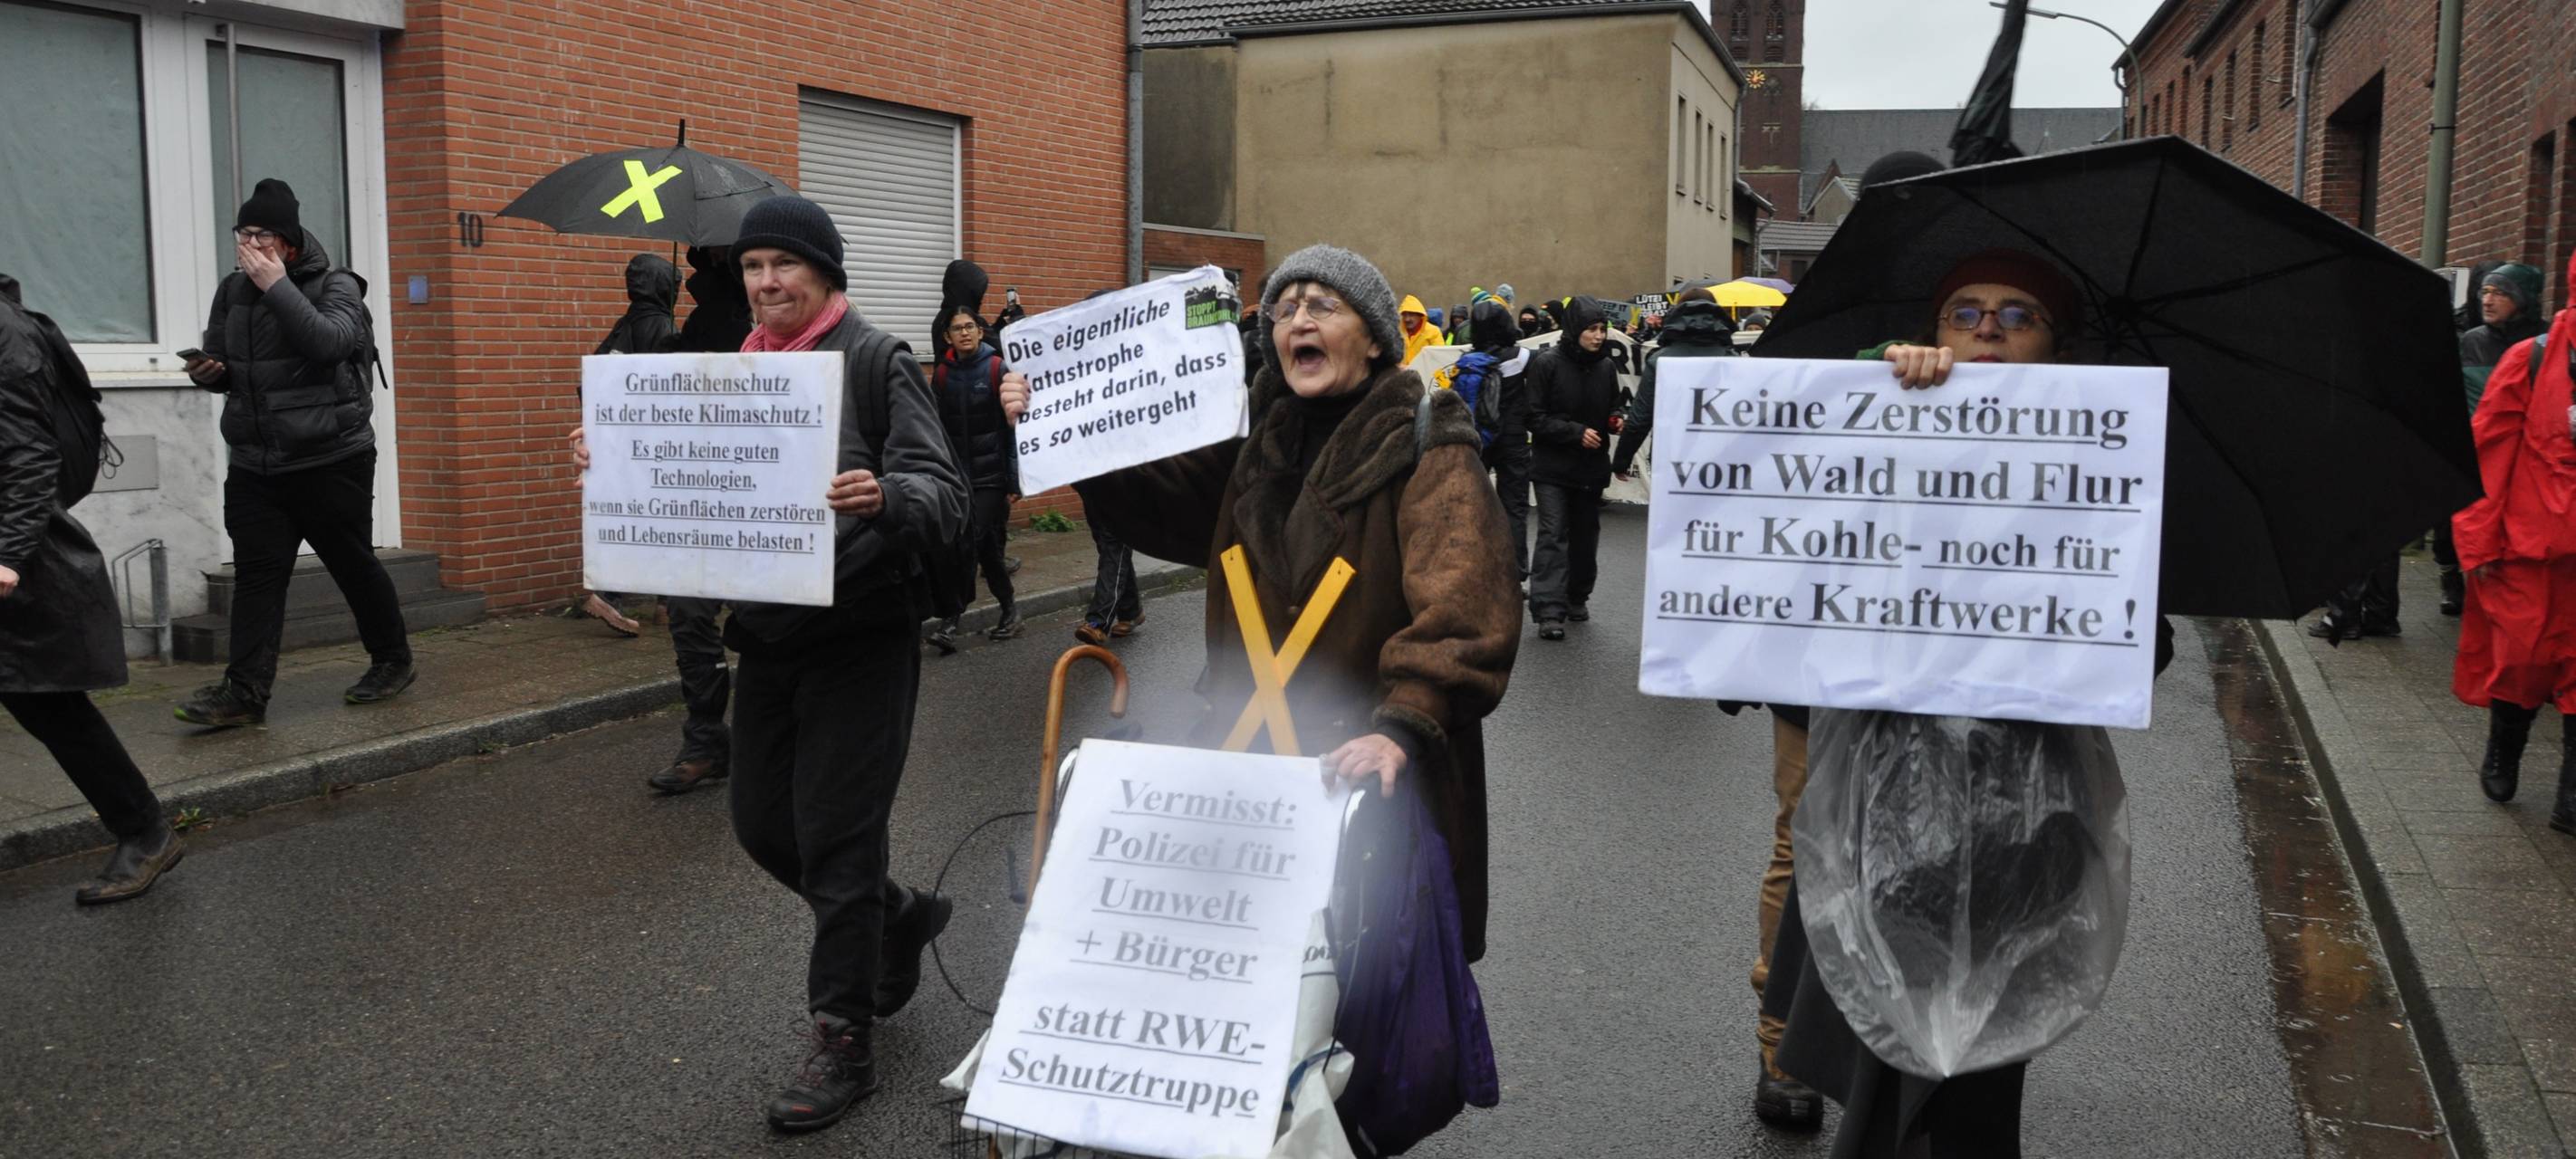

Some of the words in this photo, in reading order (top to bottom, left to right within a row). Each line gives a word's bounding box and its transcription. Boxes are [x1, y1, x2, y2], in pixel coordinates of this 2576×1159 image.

[457, 212, 484, 247] 10
[1187, 301, 1217, 317] STOPPT
[1639, 301, 1668, 311] LEIBT
[1008, 338, 1043, 364] Die
[1053, 299, 1170, 351] eigentliche
[625, 372, 791, 393] Grünflächenschutz
[1018, 388, 1094, 424] besteht
[1102, 369, 1168, 399] darin,
[1175, 351, 1226, 378] dass
[595, 403, 614, 423] ist
[619, 404, 647, 423] der
[651, 404, 694, 424] beste
[698, 404, 811, 425] Klimaschutz
[816, 404, 822, 425] !
[1019, 436, 1040, 455] es
[1049, 427, 1072, 448] so
[1078, 389, 1197, 438] weitergeht
[1687, 387, 1826, 430] Keine
[1841, 390, 2129, 449] Zerstörung
[631, 439, 649, 458] Es
[654, 441, 684, 463] gibt
[688, 441, 730, 460] keine
[734, 444, 780, 465] guten
[650, 467, 757, 492] Technologien,
[1670, 459, 1753, 491] von
[1771, 454, 1897, 496] Wald
[1917, 461, 2009, 502] und
[2031, 461, 2142, 505] Flur
[589, 501, 623, 514] wenn
[627, 499, 645, 515] sie
[649, 498, 745, 520] Grünflächen
[750, 501, 826, 522] zerstören
[598, 525, 626, 542] und
[631, 525, 734, 548] Lebensräume
[738, 530, 803, 551] belasten
[809, 532, 814, 551] !
[1684, 520, 1744, 554] für
[1760, 516, 1922, 561] Kohle-
[1939, 534, 2037, 569] noch
[2054, 535, 2119, 572] für
[1659, 585, 1793, 620] andere
[1809, 581, 2103, 638] Kraftwerke
[2124, 599, 2138, 639] !
[1120, 779, 1297, 825] Vermisst:
[1094, 826, 1223, 867] Polizei
[1236, 839, 1296, 876] für
[1100, 876, 1254, 923] Umwelt
[1076, 930, 1101, 955] +
[1113, 931, 1259, 982] Bürger
[1034, 1002, 1126, 1039] statt
[1137, 1010, 1266, 1057] RWE-
[1001, 1047, 1260, 1117] Schutztruppe
